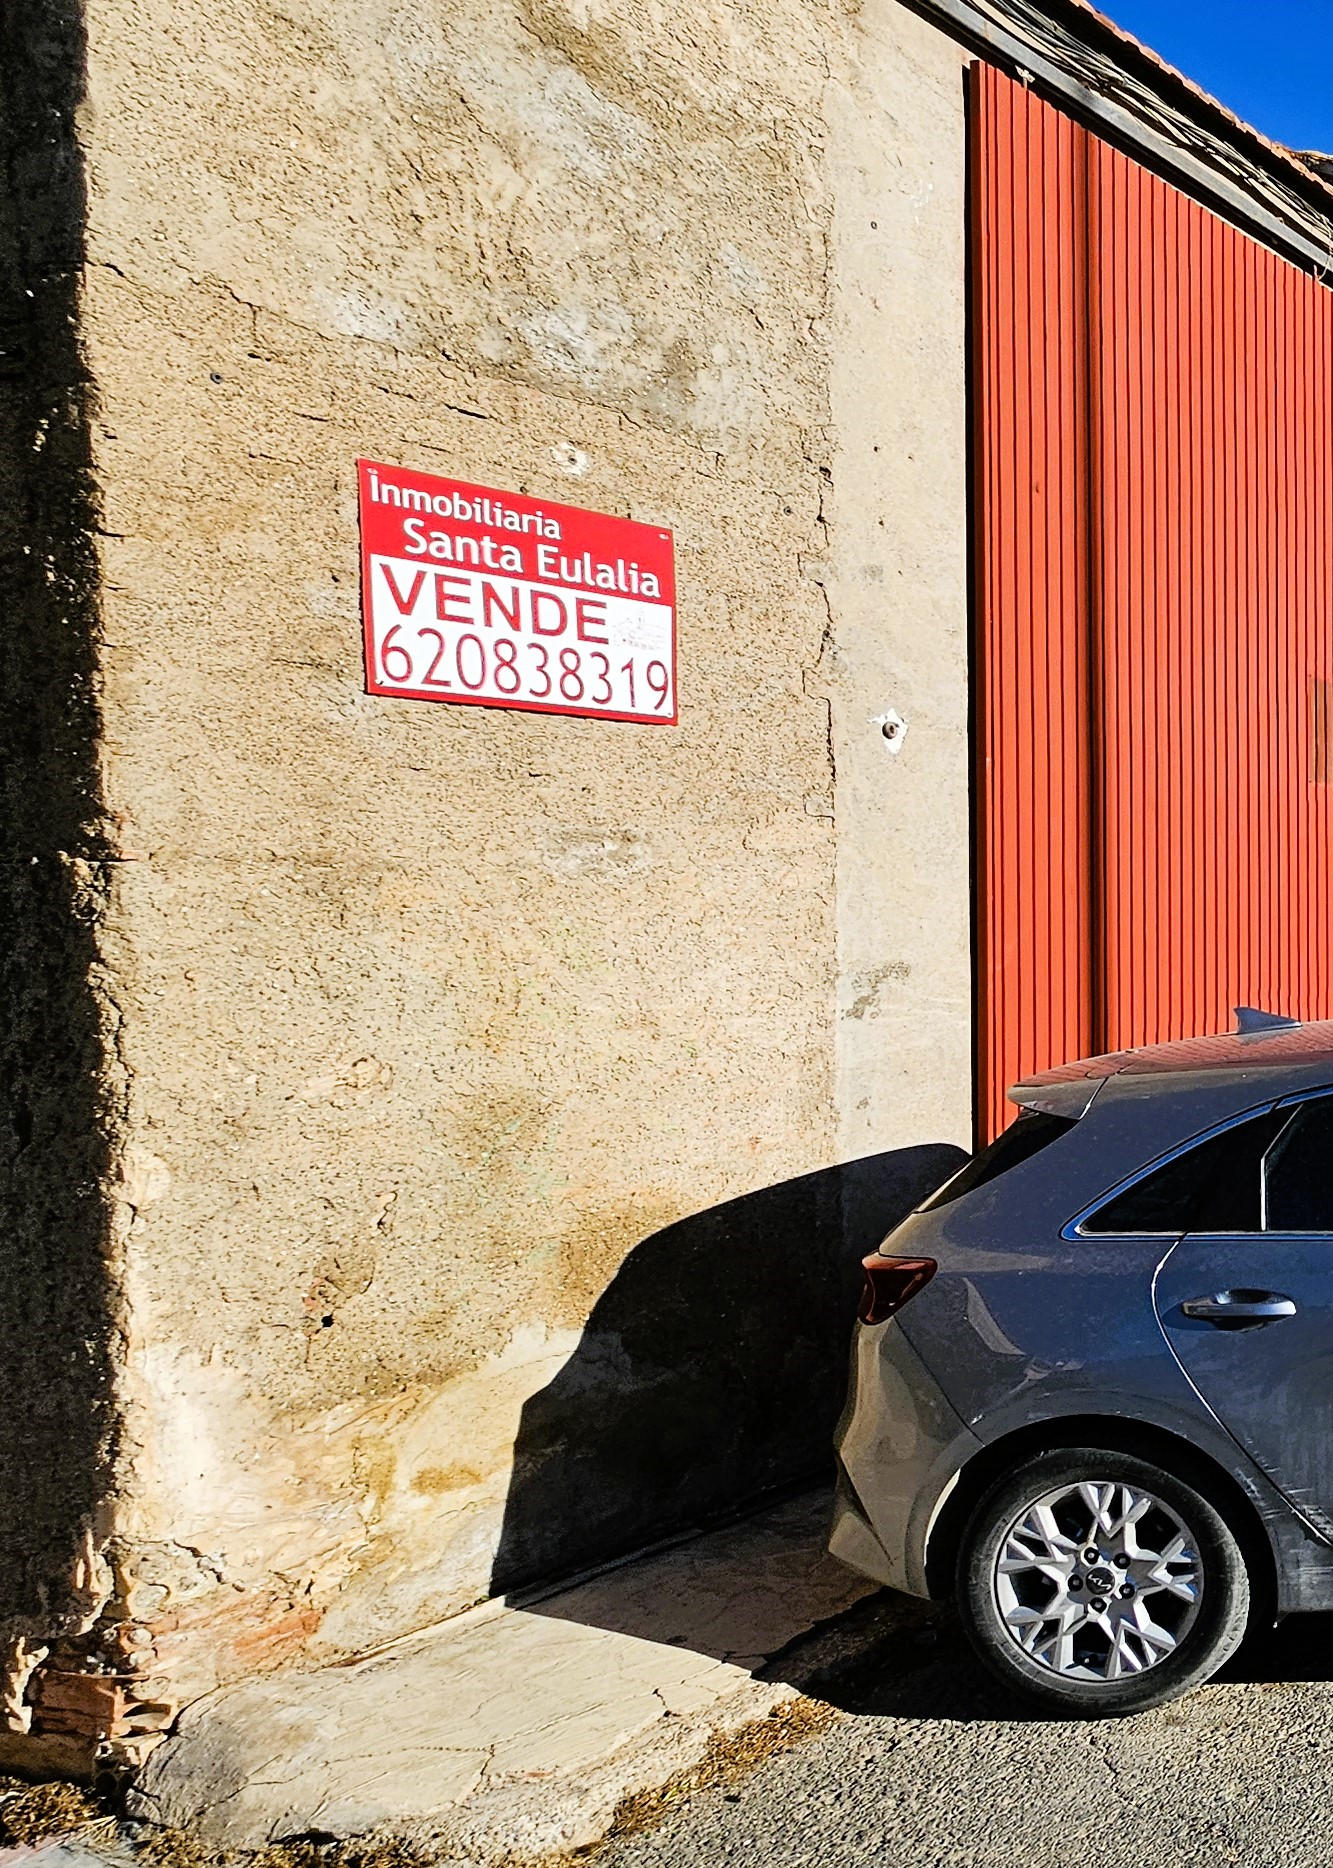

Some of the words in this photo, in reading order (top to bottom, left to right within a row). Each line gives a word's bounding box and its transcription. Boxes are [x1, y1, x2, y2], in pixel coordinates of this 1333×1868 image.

[370, 473, 562, 540] Inmobiliaria
[402, 518, 524, 574] Santa
[538, 544, 661, 598] Eulalia
[379, 563, 610, 645] VENDE
[380, 624, 669, 710] 620838319
